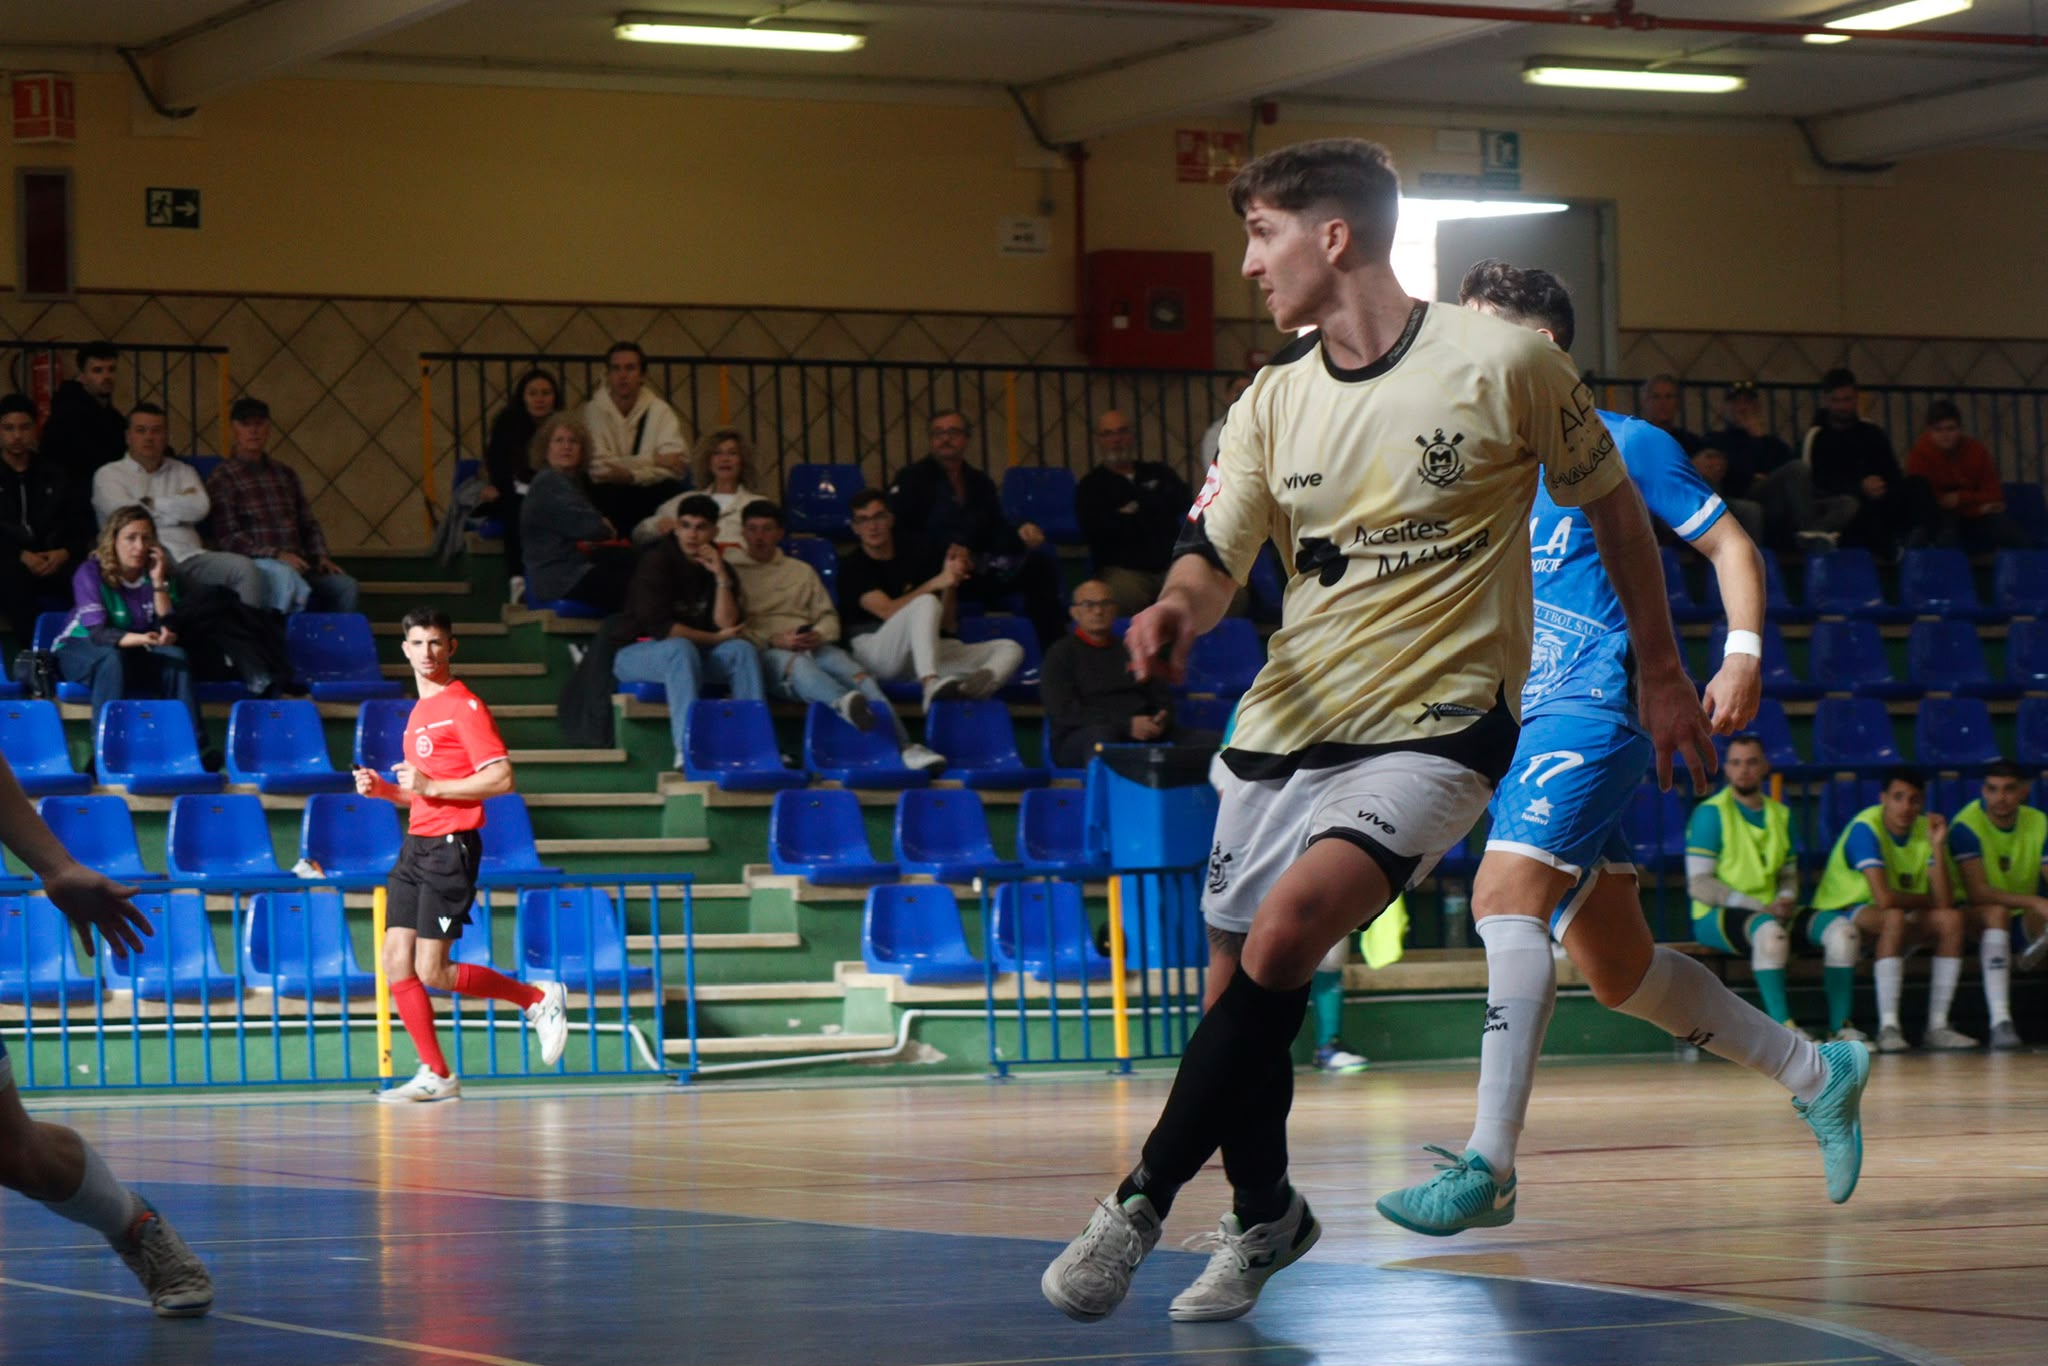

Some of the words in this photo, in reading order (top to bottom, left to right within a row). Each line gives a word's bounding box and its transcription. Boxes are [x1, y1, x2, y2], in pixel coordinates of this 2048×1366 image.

[1283, 472, 1323, 490] vive
[1349, 519, 1449, 548] Aceites
[1533, 604, 1573, 629] UTBOL
[1357, 809, 1397, 835] vive
